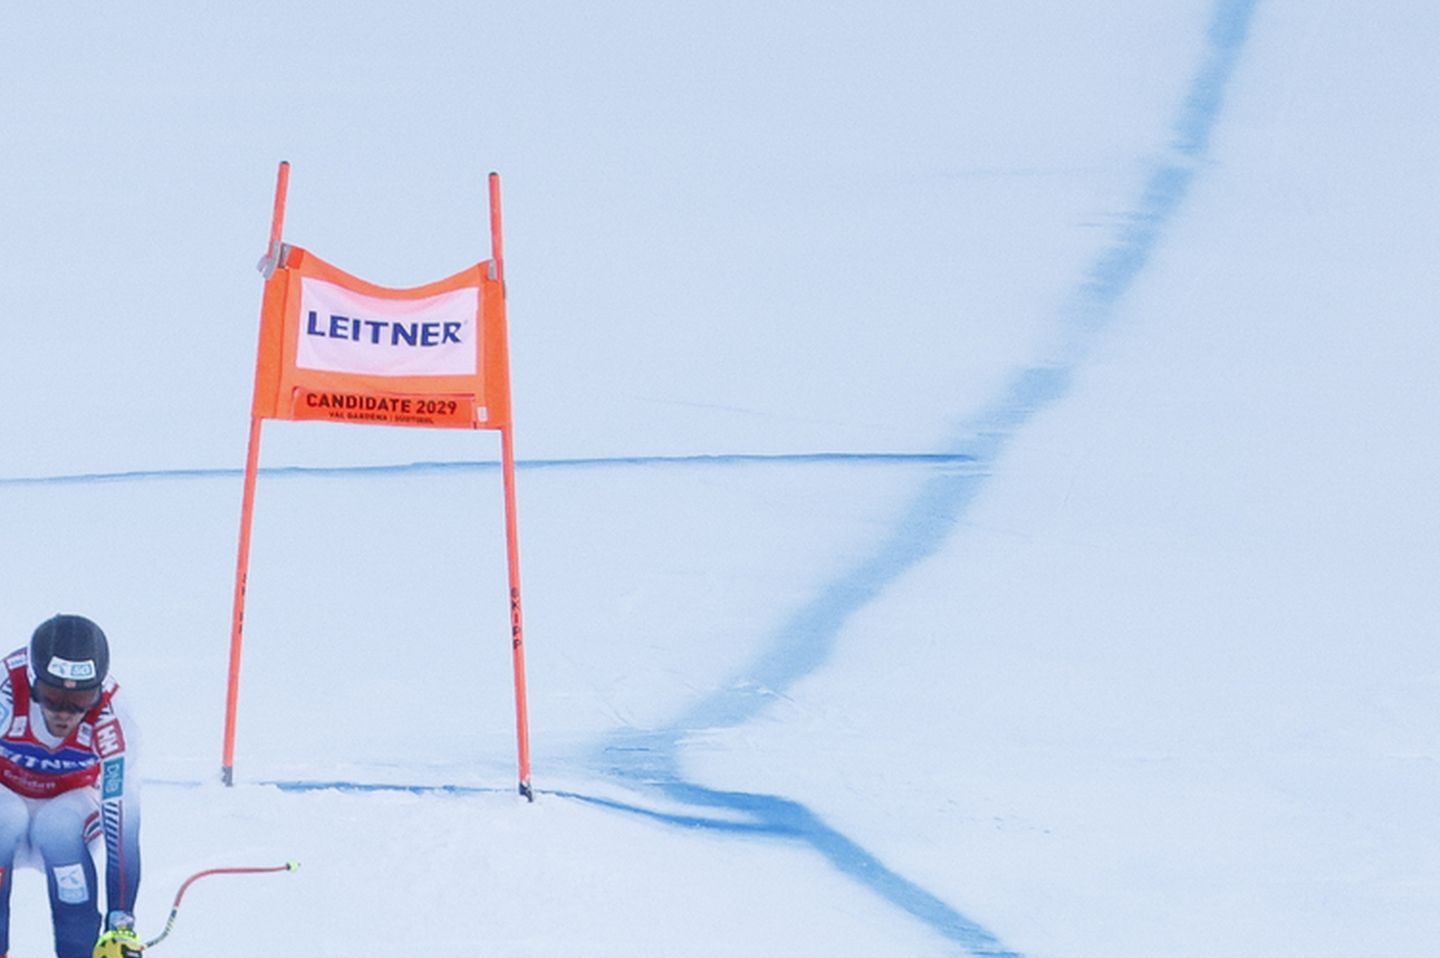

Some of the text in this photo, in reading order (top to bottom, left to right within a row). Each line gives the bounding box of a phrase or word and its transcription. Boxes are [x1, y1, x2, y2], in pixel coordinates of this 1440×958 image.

[307, 311, 463, 346] LEITNER
[306, 393, 458, 415] CANDIDATE 2029
